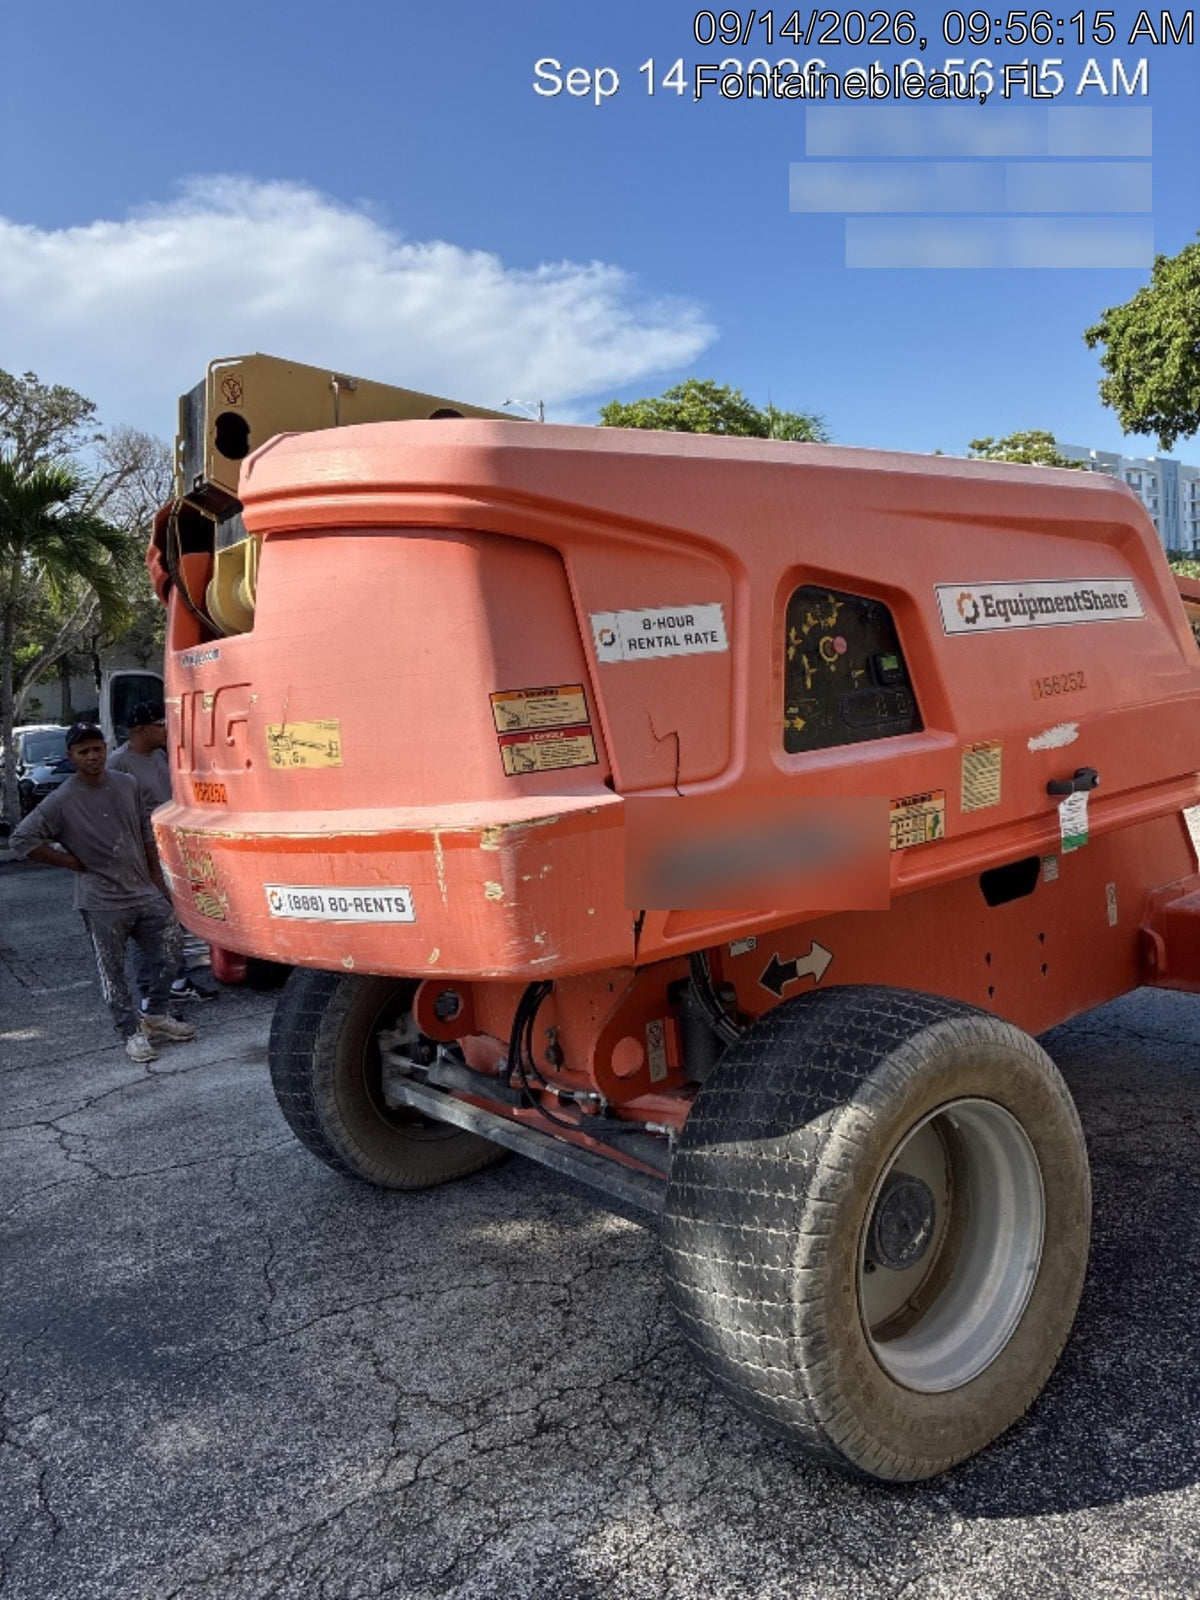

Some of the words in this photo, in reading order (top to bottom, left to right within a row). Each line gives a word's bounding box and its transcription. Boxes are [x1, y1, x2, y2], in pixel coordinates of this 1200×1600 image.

[980, 589, 1128, 622] EquipmentShare
[642, 614, 695, 631] 8-HOUR
[627, 635, 680, 651] RENTAL
[683, 629, 719, 645] RATE
[1035, 670, 1087, 697] 156252
